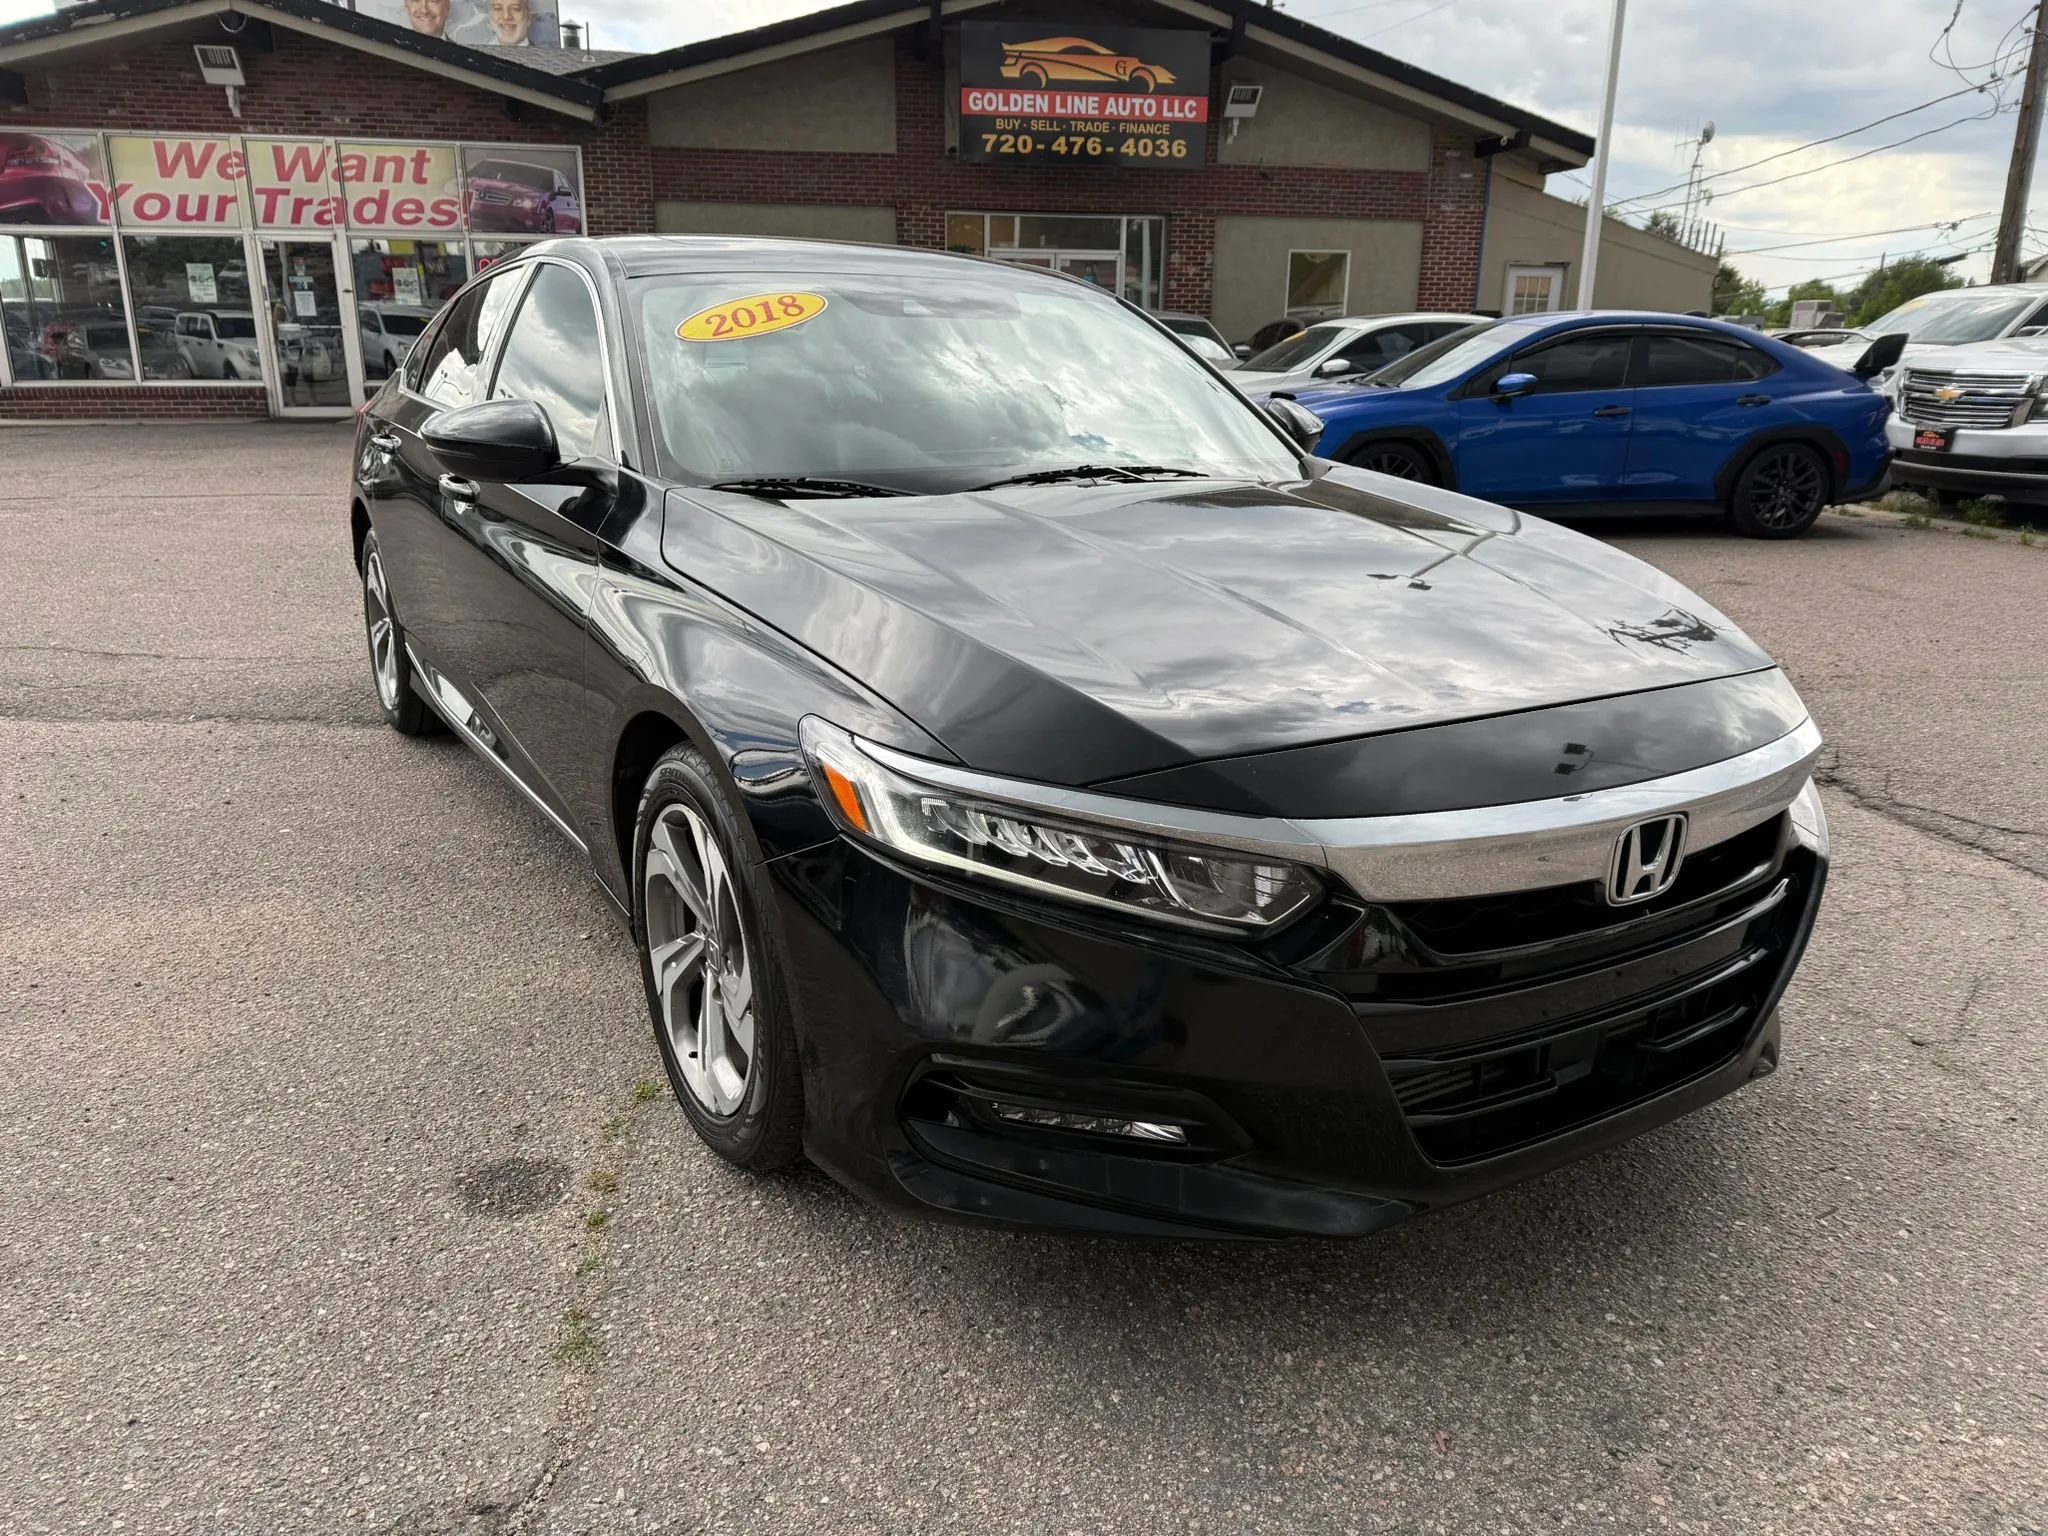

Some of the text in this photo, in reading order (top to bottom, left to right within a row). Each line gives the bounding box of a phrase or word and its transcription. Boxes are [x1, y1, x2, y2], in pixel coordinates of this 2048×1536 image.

[968, 91, 1197, 118] GOLDEN LINE AUTO LLC
[995, 118, 1171, 134] BUY SELL TRADE FINANCE
[153, 141, 432, 185] We Want
[86, 182, 475, 227] Your Trades!
[705, 295, 805, 337] 2018
